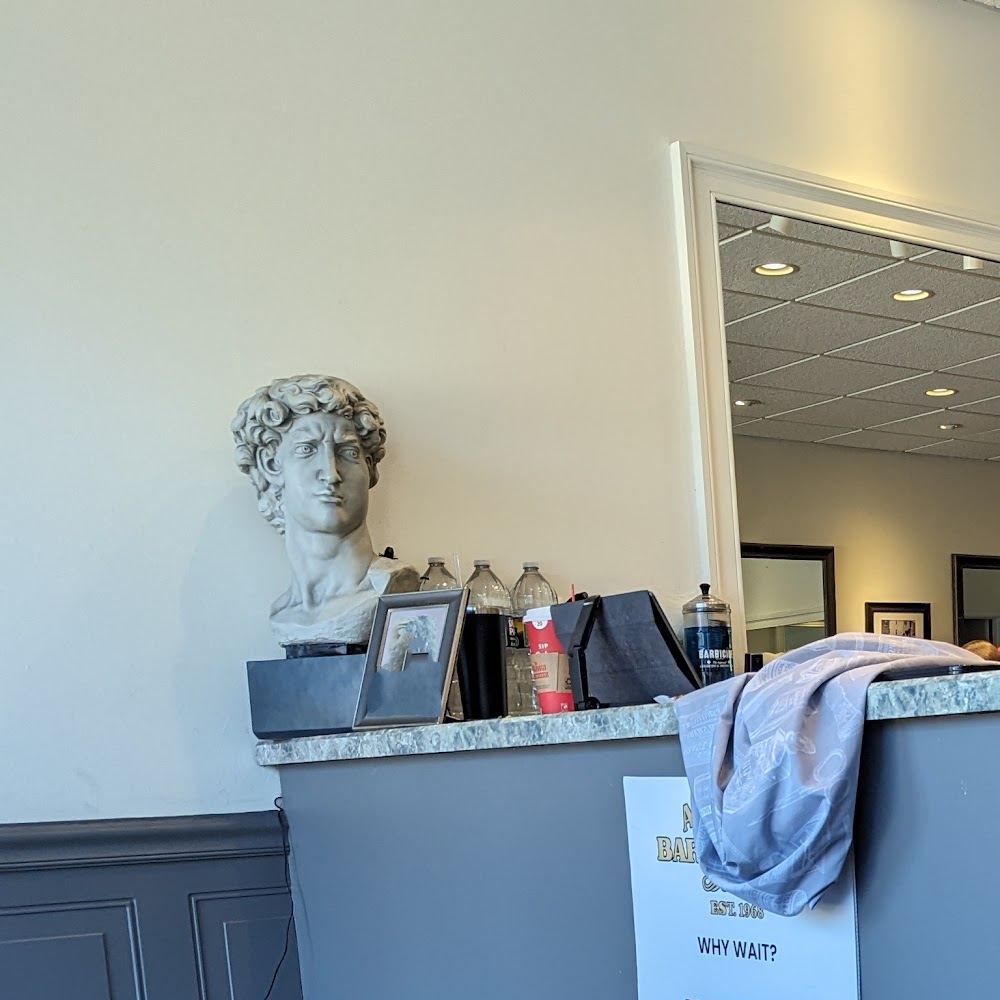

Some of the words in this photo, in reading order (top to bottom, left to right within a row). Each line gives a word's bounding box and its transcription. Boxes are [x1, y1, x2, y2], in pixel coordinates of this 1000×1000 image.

[538, 642, 549, 650] SIP
[657, 836, 699, 864] BAR
[710, 900, 737, 917] EST.
[738, 903, 764, 919] 1968
[697, 936, 729, 957] WHY
[733, 940, 777, 962] WAIT?
